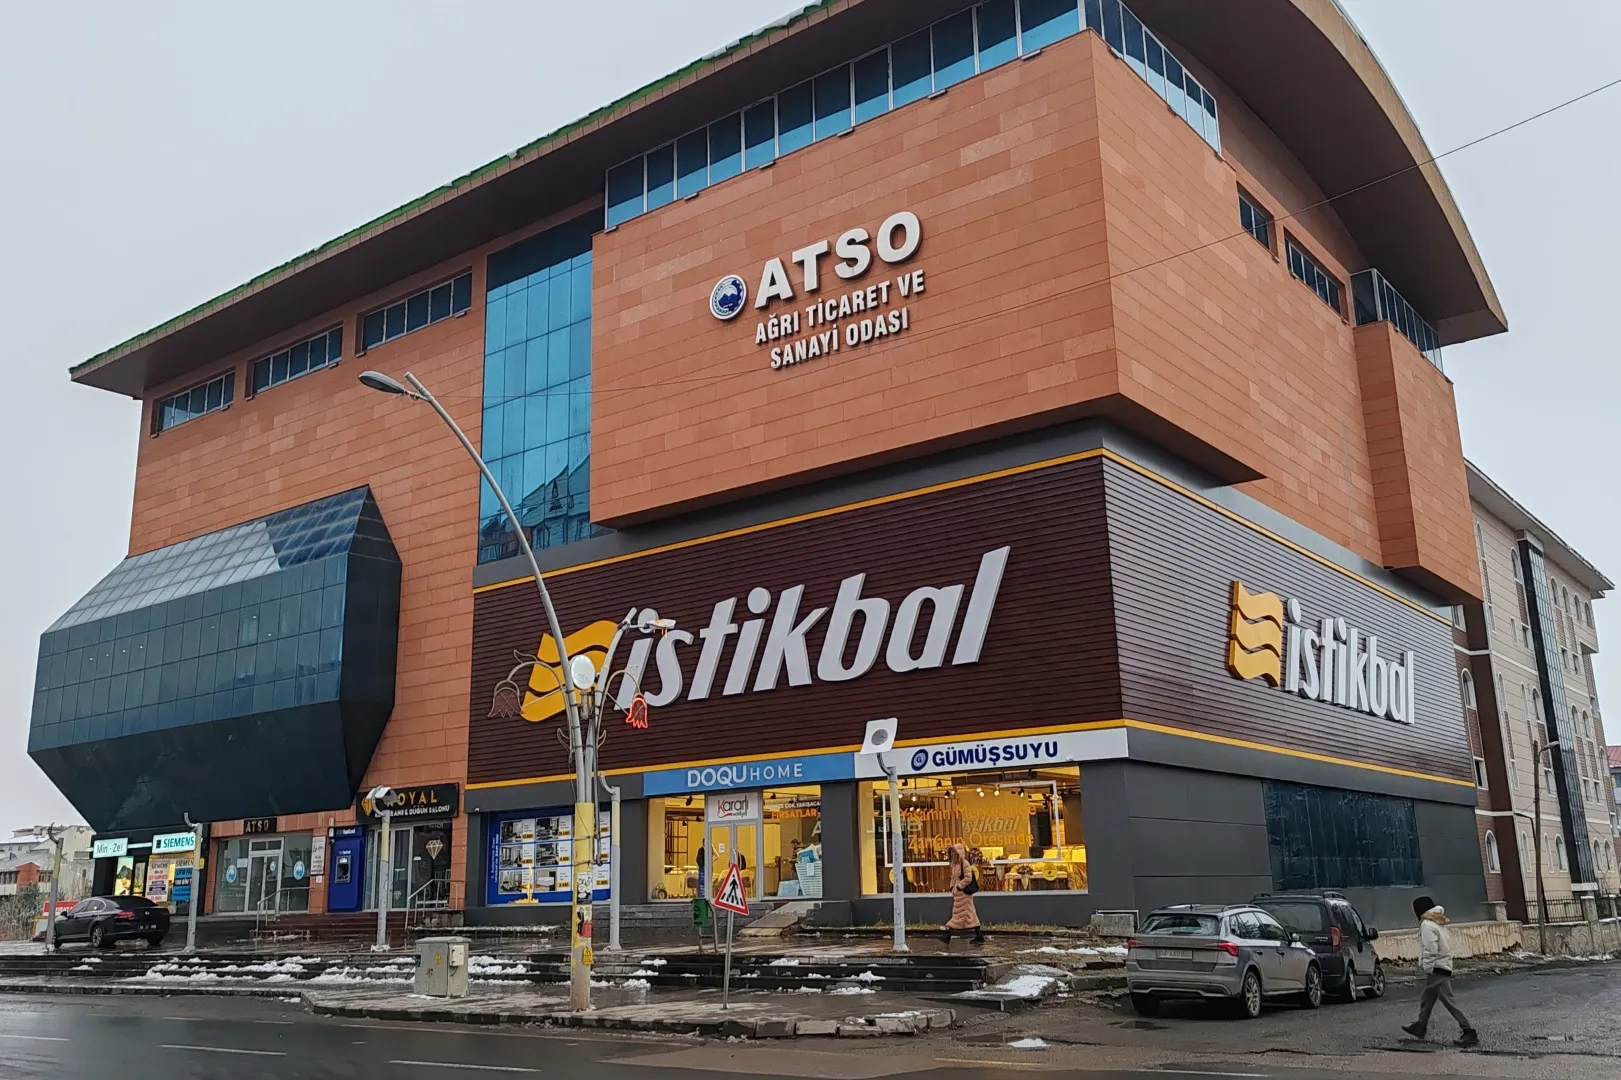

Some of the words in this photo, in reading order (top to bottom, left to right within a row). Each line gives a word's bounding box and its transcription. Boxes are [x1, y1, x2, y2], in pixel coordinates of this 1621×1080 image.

[754, 211, 923, 309] ATSO
[755, 311, 800, 344] AĞRI
[806, 280, 891, 327] TİCARET
[897, 269, 925, 297] VE
[770, 324, 838, 369] SANAYİ
[845, 307, 909, 347] ODASI
[613, 545, 1011, 710] istikbal
[1285, 598, 1414, 724] istikbal
[932, 741, 1058, 767] GÜMÜŞSUYU
[687, 765, 747, 787] DOQU
[750, 763, 803, 781] HOME
[397, 790, 437, 806] OYAL
[429, 805, 450, 813] SALONU
[245, 820, 269, 832] ATSO
[163, 836, 195, 848] SIEMENS
